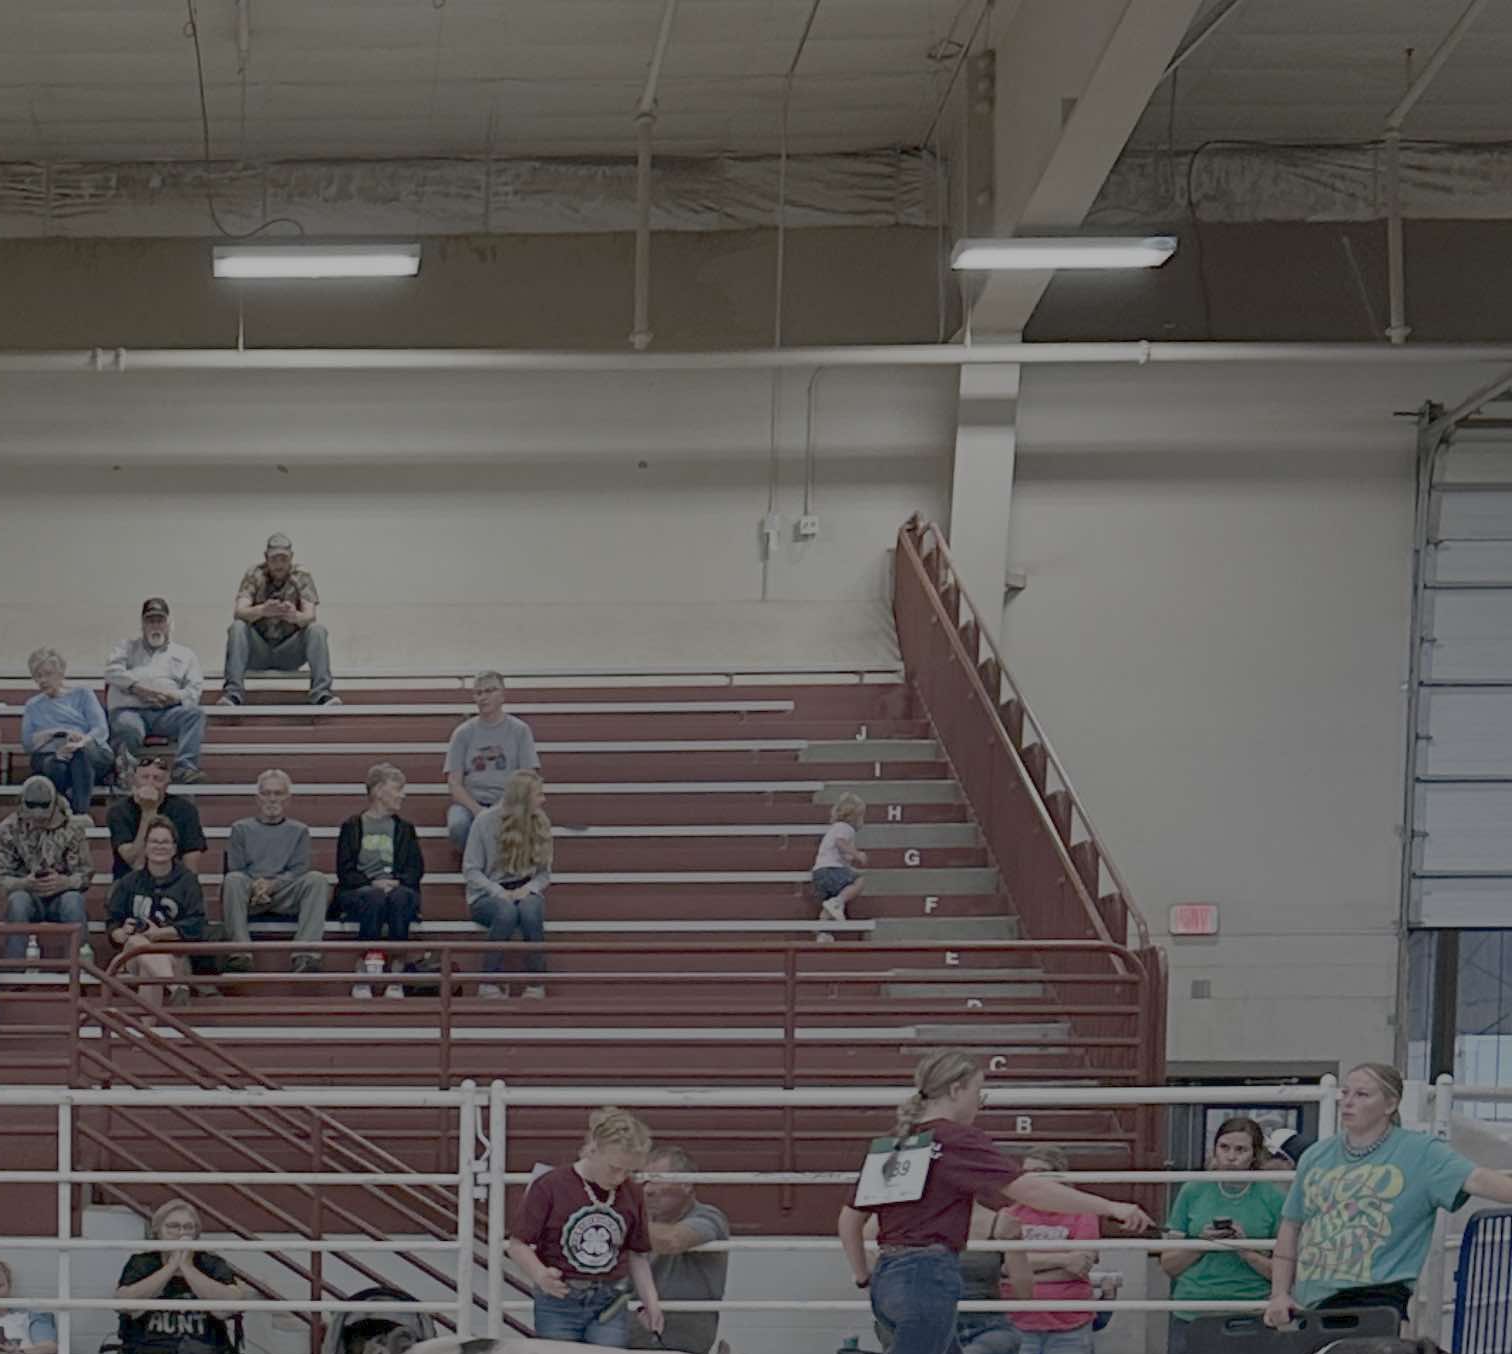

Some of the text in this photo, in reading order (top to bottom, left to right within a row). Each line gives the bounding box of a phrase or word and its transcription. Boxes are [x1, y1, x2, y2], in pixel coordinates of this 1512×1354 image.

[855, 725, 867, 740] J
[874, 762, 881, 777] I
[888, 805, 901, 821] H
[904, 849, 920, 866] G
[924, 896, 939, 914] F
[990, 1056, 1008, 1072] C
[1016, 1115, 1033, 1134] B
[1303, 1164, 1405, 1210] GOOD
[1297, 1238, 1385, 1281] ONLY
[148, 1312, 207, 1337] AUNT
